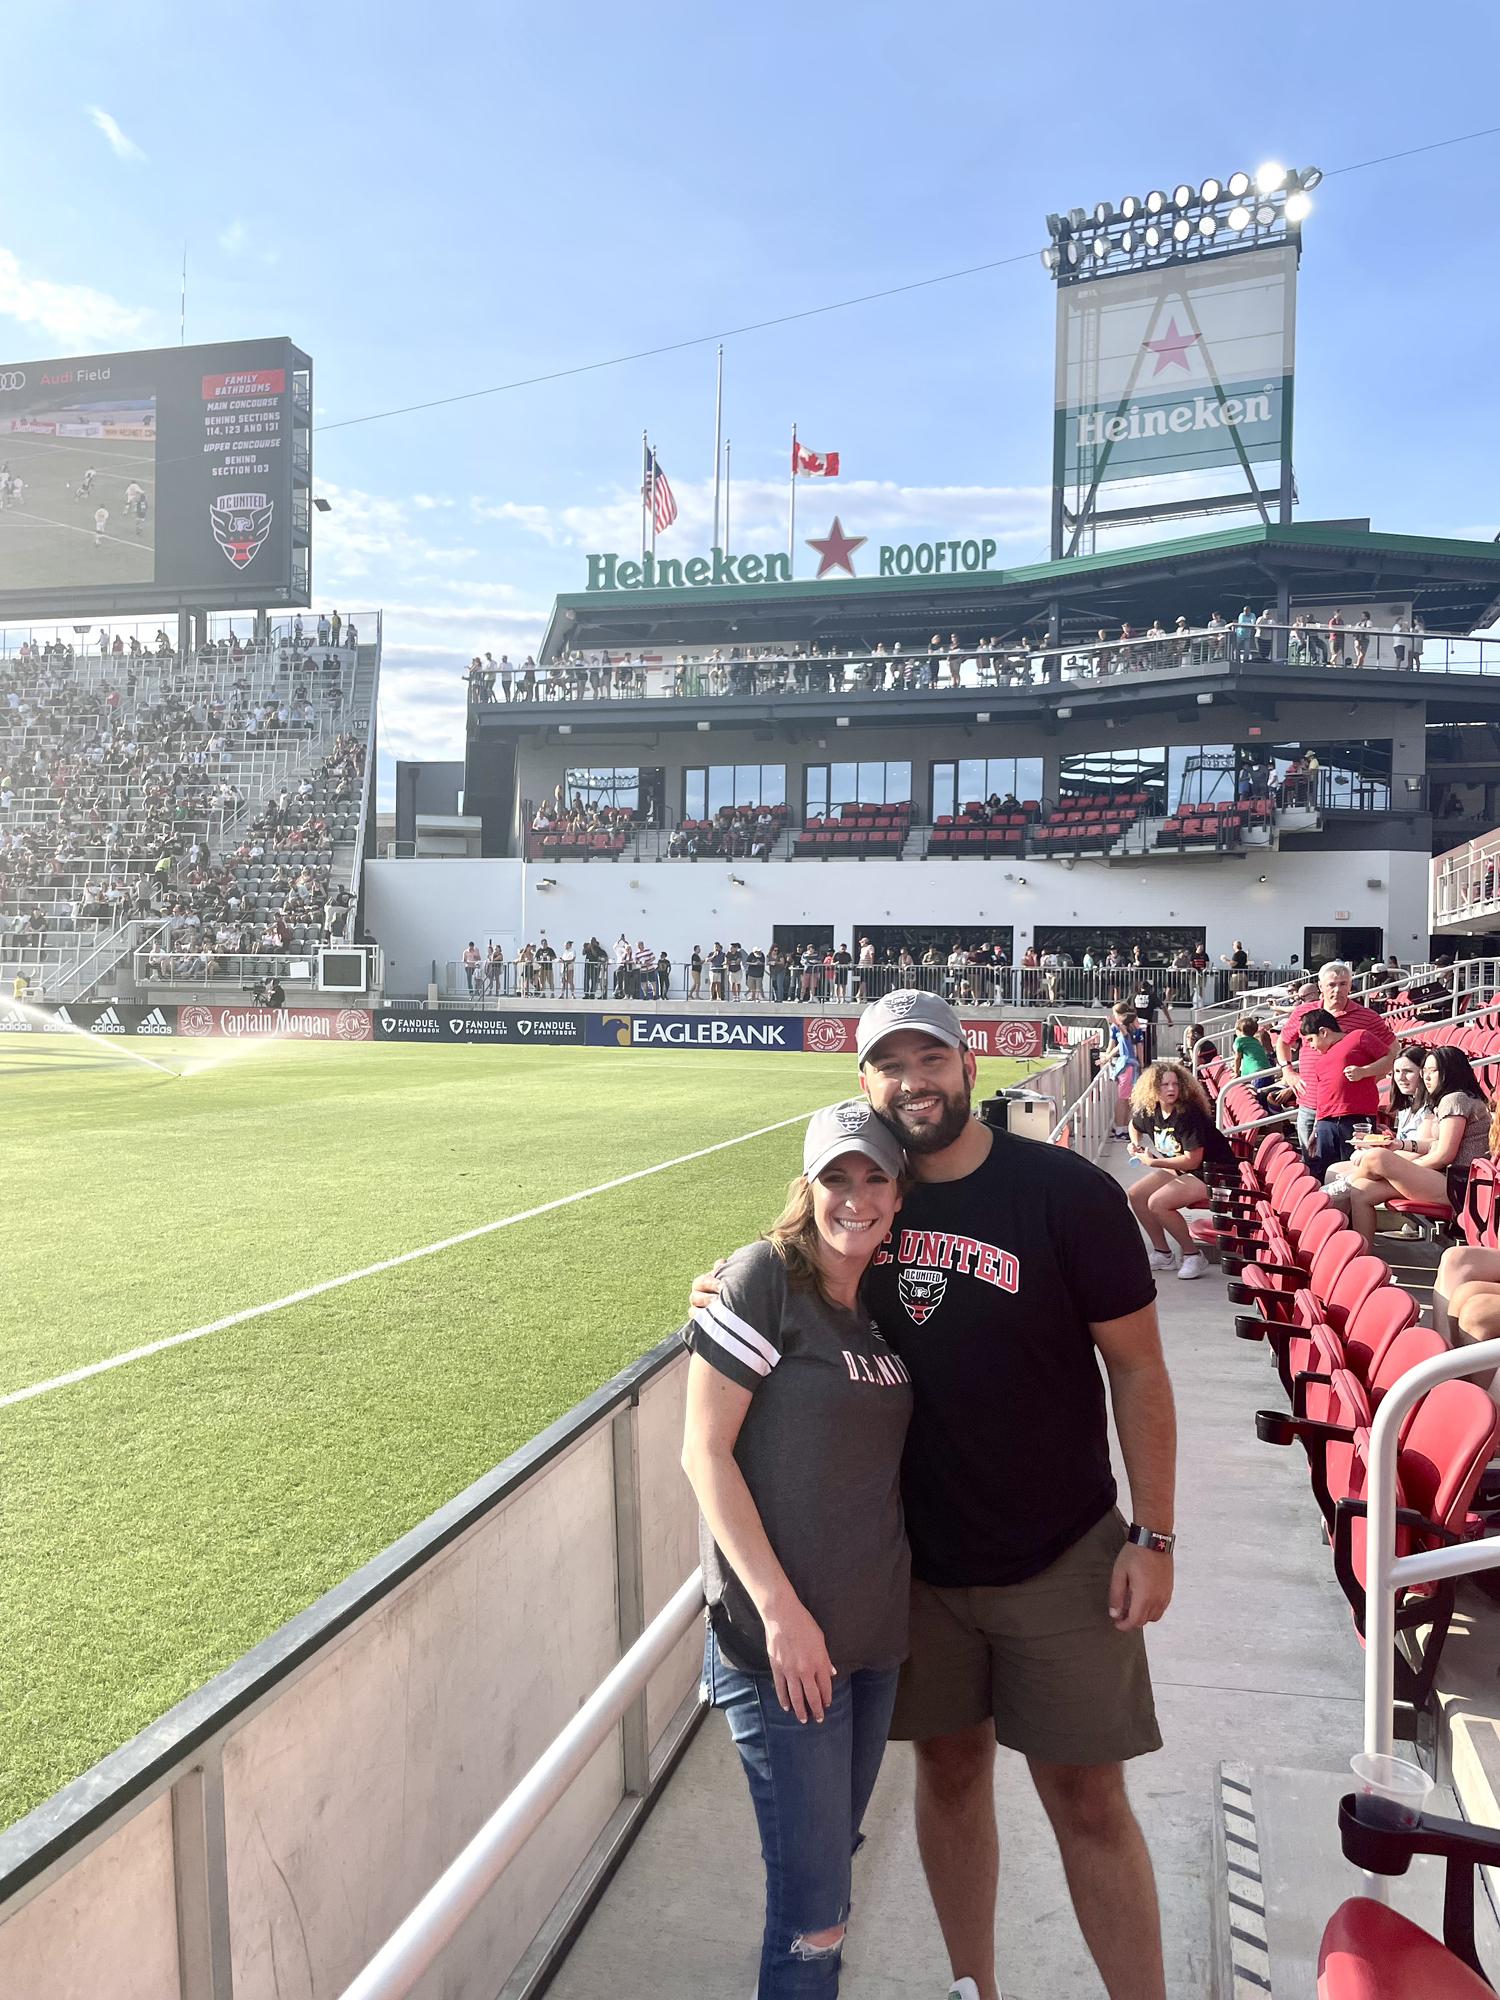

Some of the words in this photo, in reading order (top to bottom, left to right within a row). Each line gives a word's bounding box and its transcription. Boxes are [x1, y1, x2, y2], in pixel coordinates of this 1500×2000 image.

[40, 372, 73, 385] Audi
[77, 368, 111, 382] Field
[225, 374, 258, 385] FAMILY
[215, 383, 271, 396] BATHROOMS
[207, 401, 228, 411] MAIN
[229, 397, 279, 409] CONCOURSE
[204, 415, 236, 426] BEHIND
[238, 411, 280, 423] SECTIONS
[1075, 393, 1273, 447] Heineken
[225, 425, 241, 434] 123
[243, 423, 262, 433] AND
[265, 422, 279, 431] 131
[203, 442, 231, 452] UPPER
[232, 438, 281, 450] CONCOURSE
[225, 454, 257, 465] BEHIND
[212, 465, 250, 476] SECTION
[253, 464, 269, 473] 103
[586, 547, 793, 591] Heineken
[879, 538, 997, 577] ROOFTOP
[91, 1023, 126, 1033] adidas
[220, 1009, 272, 1037] Captain
[272, 1008, 330, 1037] Morgan
[398, 1019, 439, 1028] FANDUEL
[465, 1020, 507, 1029] FANDUEL
[534, 1021, 576, 1030] FANDUEL
[137, 1024, 172, 1034] adidas
[898, 1229, 1020, 1294] UNITED
